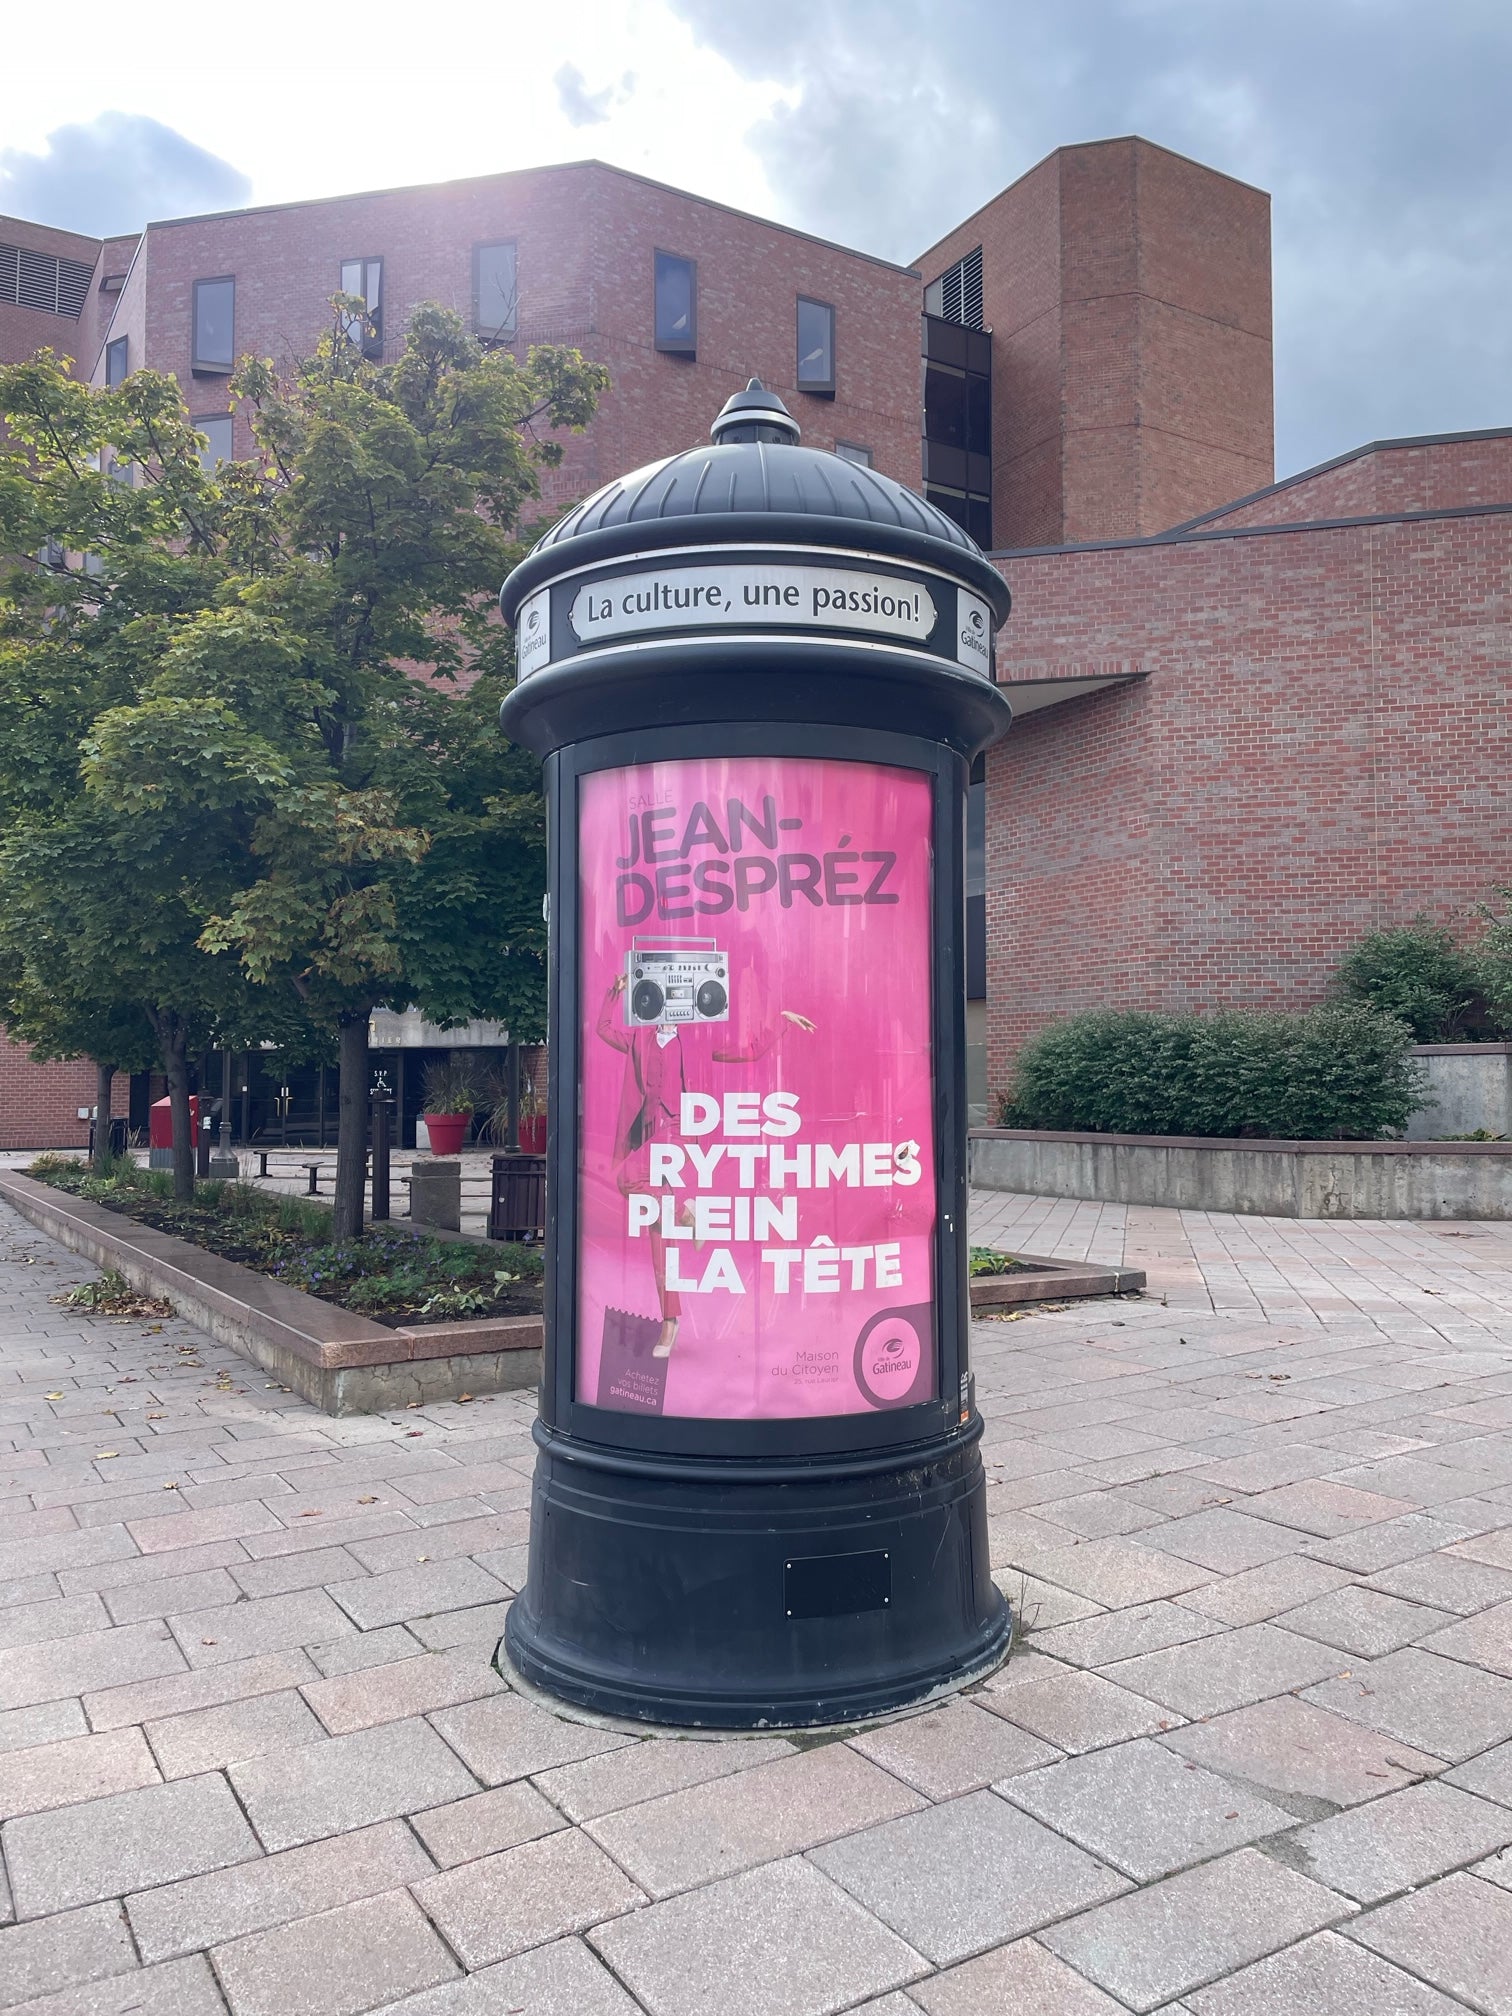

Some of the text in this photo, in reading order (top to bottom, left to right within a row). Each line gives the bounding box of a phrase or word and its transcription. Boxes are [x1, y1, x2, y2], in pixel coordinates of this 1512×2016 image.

[588, 582, 919, 622] La culture, une passion!
[961, 630, 988, 659] Gatineau
[628, 789, 674, 810] SALLE
[616, 795, 803, 869] JEAN-
[616, 834, 900, 927] DESPRÉZ
[680, 1092, 801, 1137] DES
[650, 1140, 922, 1189] RYTHMES
[628, 1194, 798, 1241] PLEIN
[665, 1235, 903, 1294] LA TÊTE
[771, 1364, 839, 1376] du Citoyen
[796, 1351, 839, 1361] Maison
[872, 1359, 912, 1375] Gatineau
[617, 1378, 659, 1396] vos billets
[624, 1368, 660, 1385] Achetez
[609, 1385, 657, 1406] gatineau.ca
